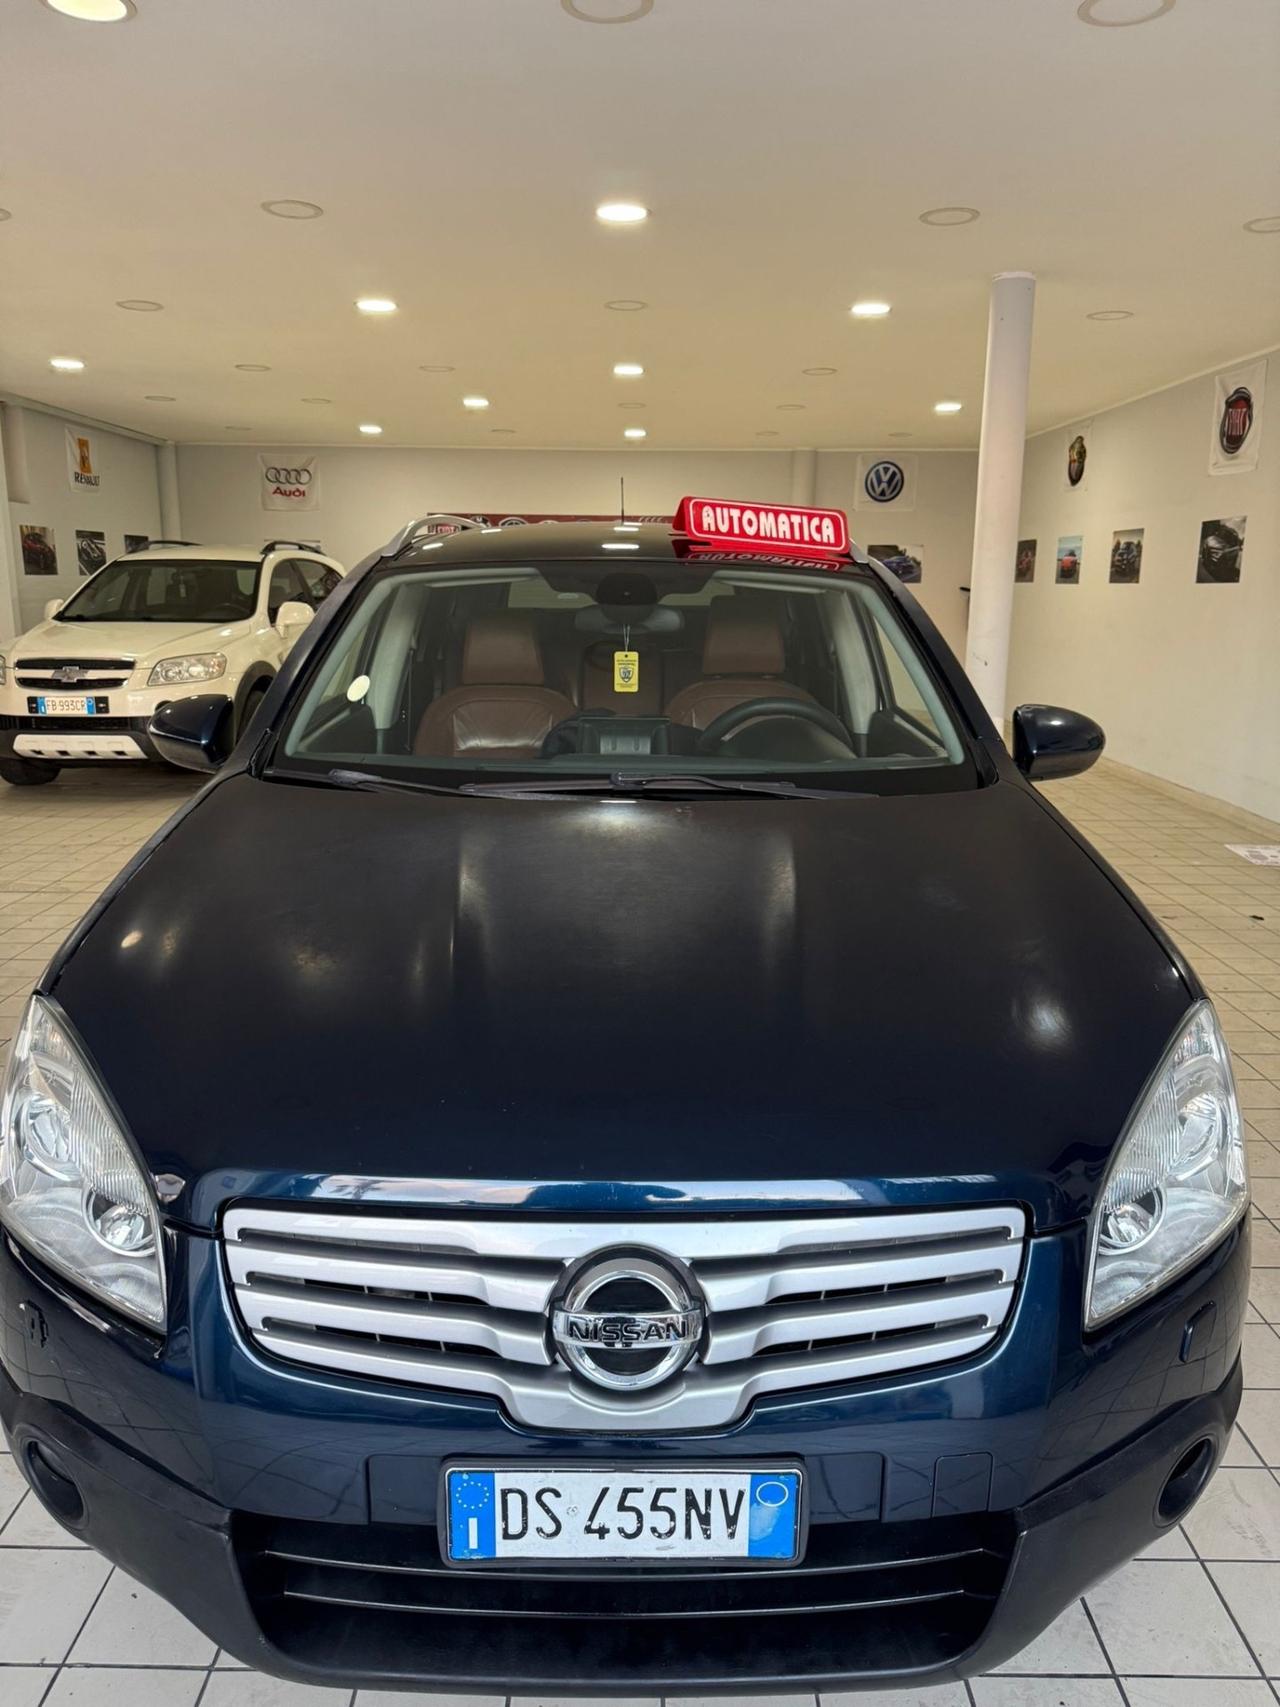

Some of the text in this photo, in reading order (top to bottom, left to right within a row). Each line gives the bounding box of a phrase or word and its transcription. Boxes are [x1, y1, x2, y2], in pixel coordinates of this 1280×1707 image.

[1228, 408, 1247, 436] FIAT
[272, 486, 306, 497] Audi
[702, 505, 835, 544] AUTOMATICA
[46, 699, 58, 711] FB
[569, 1320, 687, 1342] NISSAN
[500, 1487, 563, 1541] DS
[584, 1486, 746, 1541] 455NV
